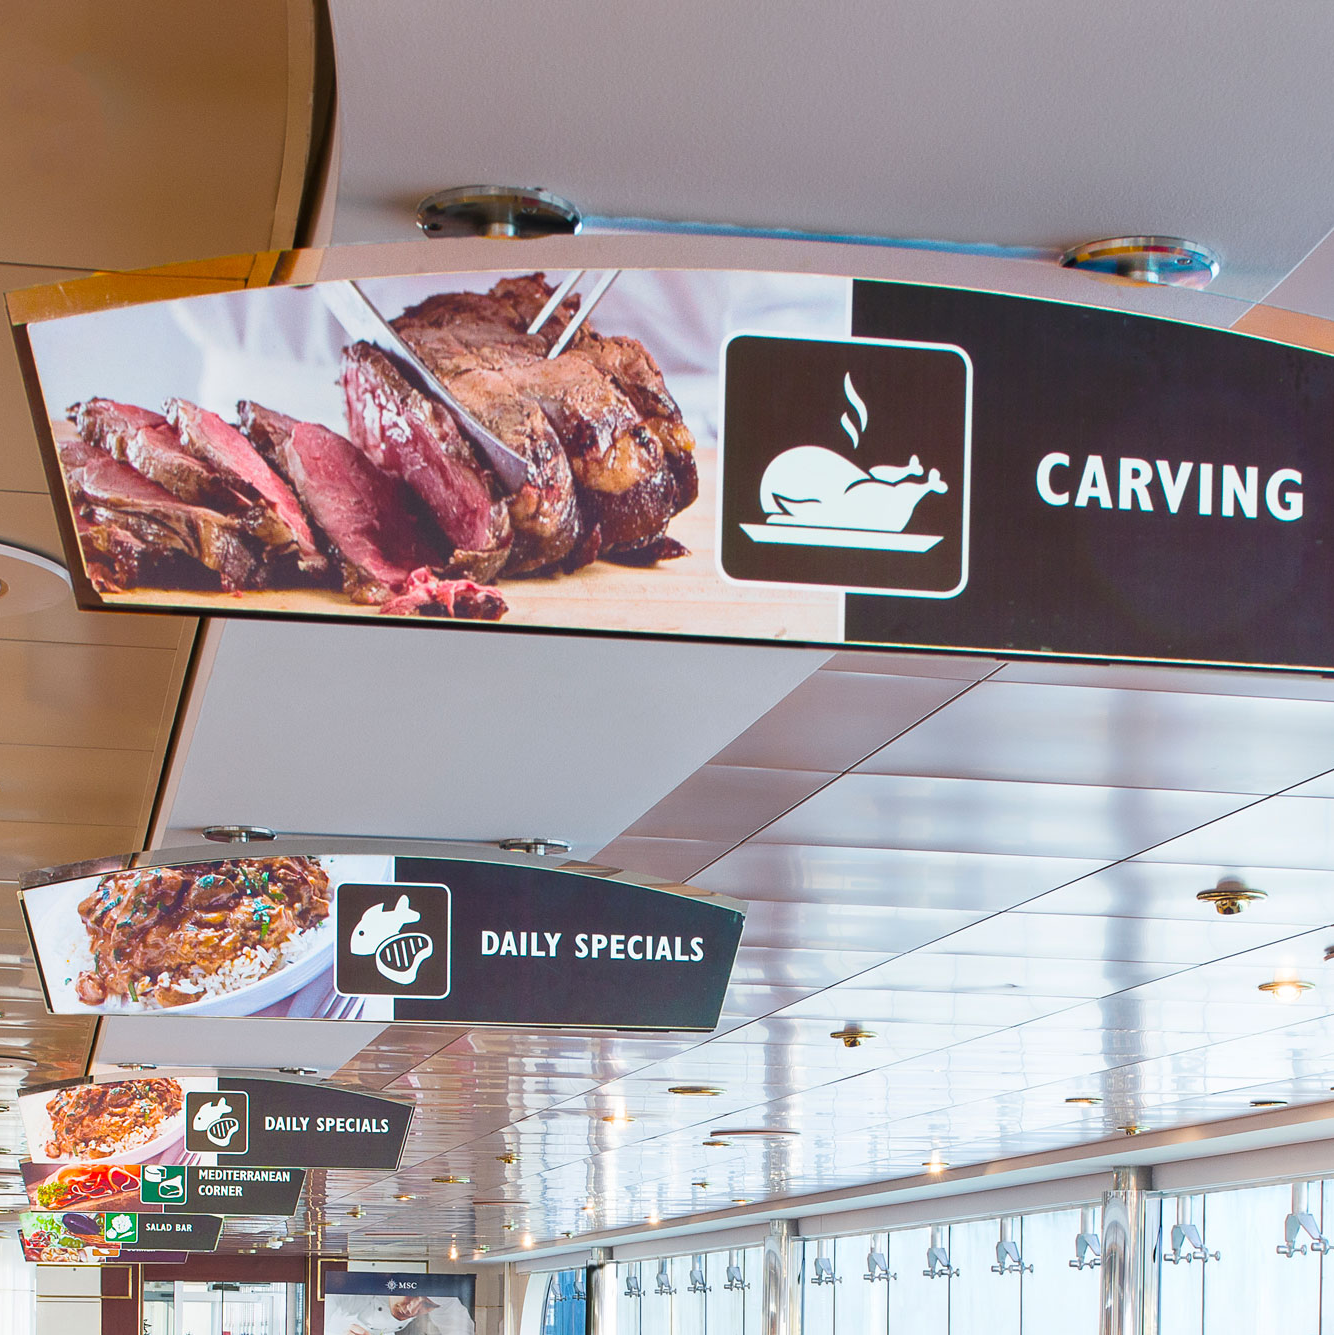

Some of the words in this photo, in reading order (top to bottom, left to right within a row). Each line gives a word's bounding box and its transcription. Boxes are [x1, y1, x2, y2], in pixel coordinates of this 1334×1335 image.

[1036, 452, 1304, 522] CARVING
[481, 930, 562, 957] DAILY
[574, 933, 704, 962] SPECIALS
[264, 1116, 310, 1131] DAILY
[316, 1117, 389, 1133] SPECIALS
[198, 1169, 291, 1182] MEDITERRANEAN
[198, 1184, 243, 1196] CORNER
[145, 1223, 172, 1232] SALAD
[175, 1223, 192, 1232] BAR
